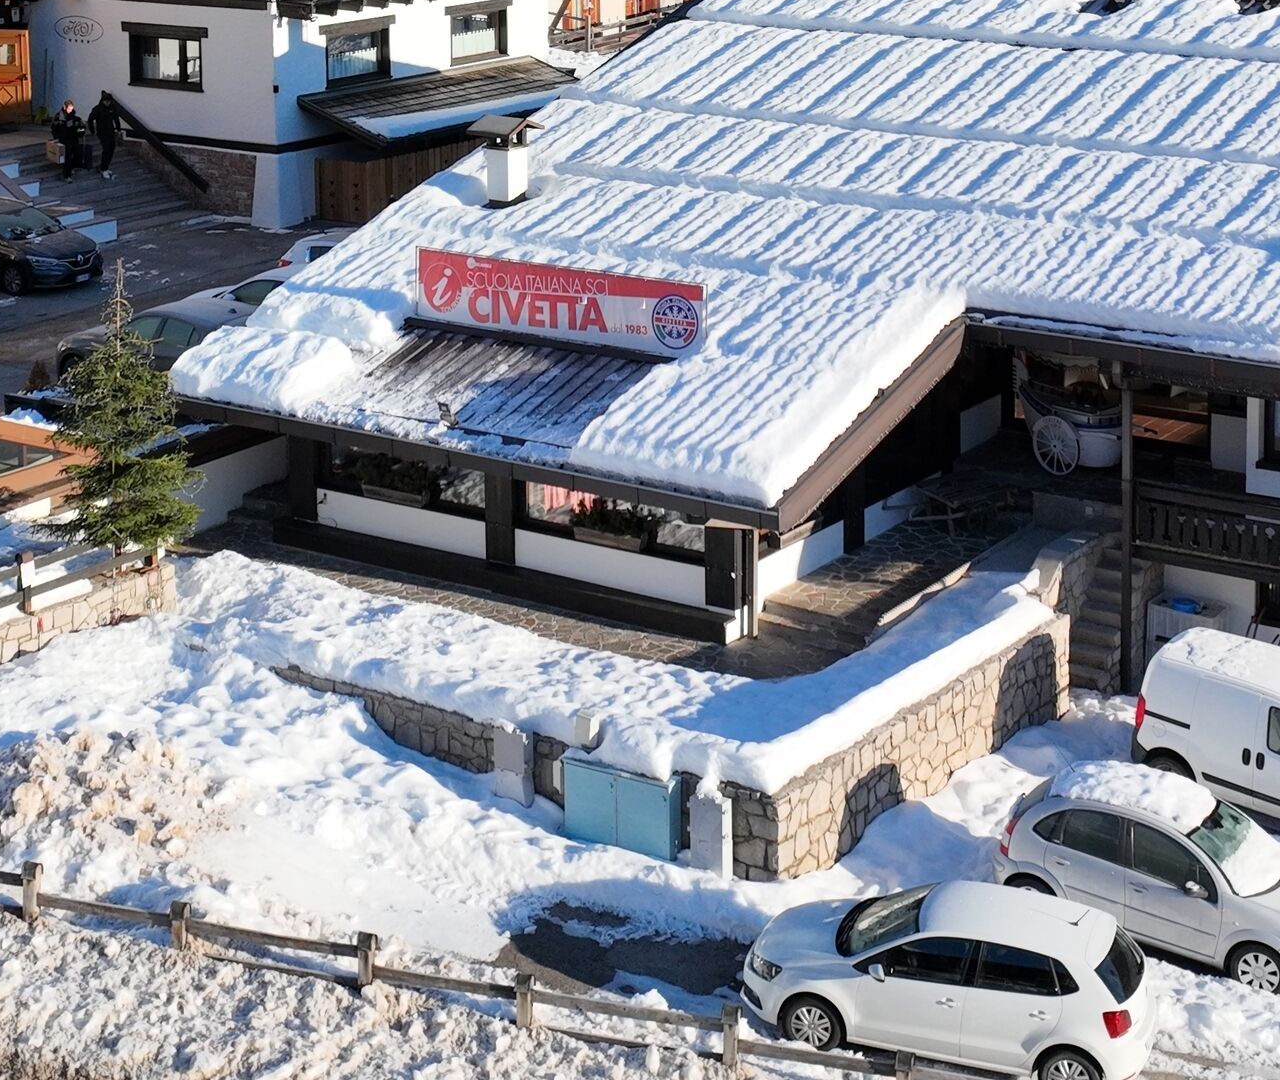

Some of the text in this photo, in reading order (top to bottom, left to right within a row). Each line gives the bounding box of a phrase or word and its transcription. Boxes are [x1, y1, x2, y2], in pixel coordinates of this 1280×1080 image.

[466, 270, 609, 296] SCUOLA ITALIANA SCI
[467, 288, 609, 334] CIVETTA
[625, 324, 648, 336] 1983
